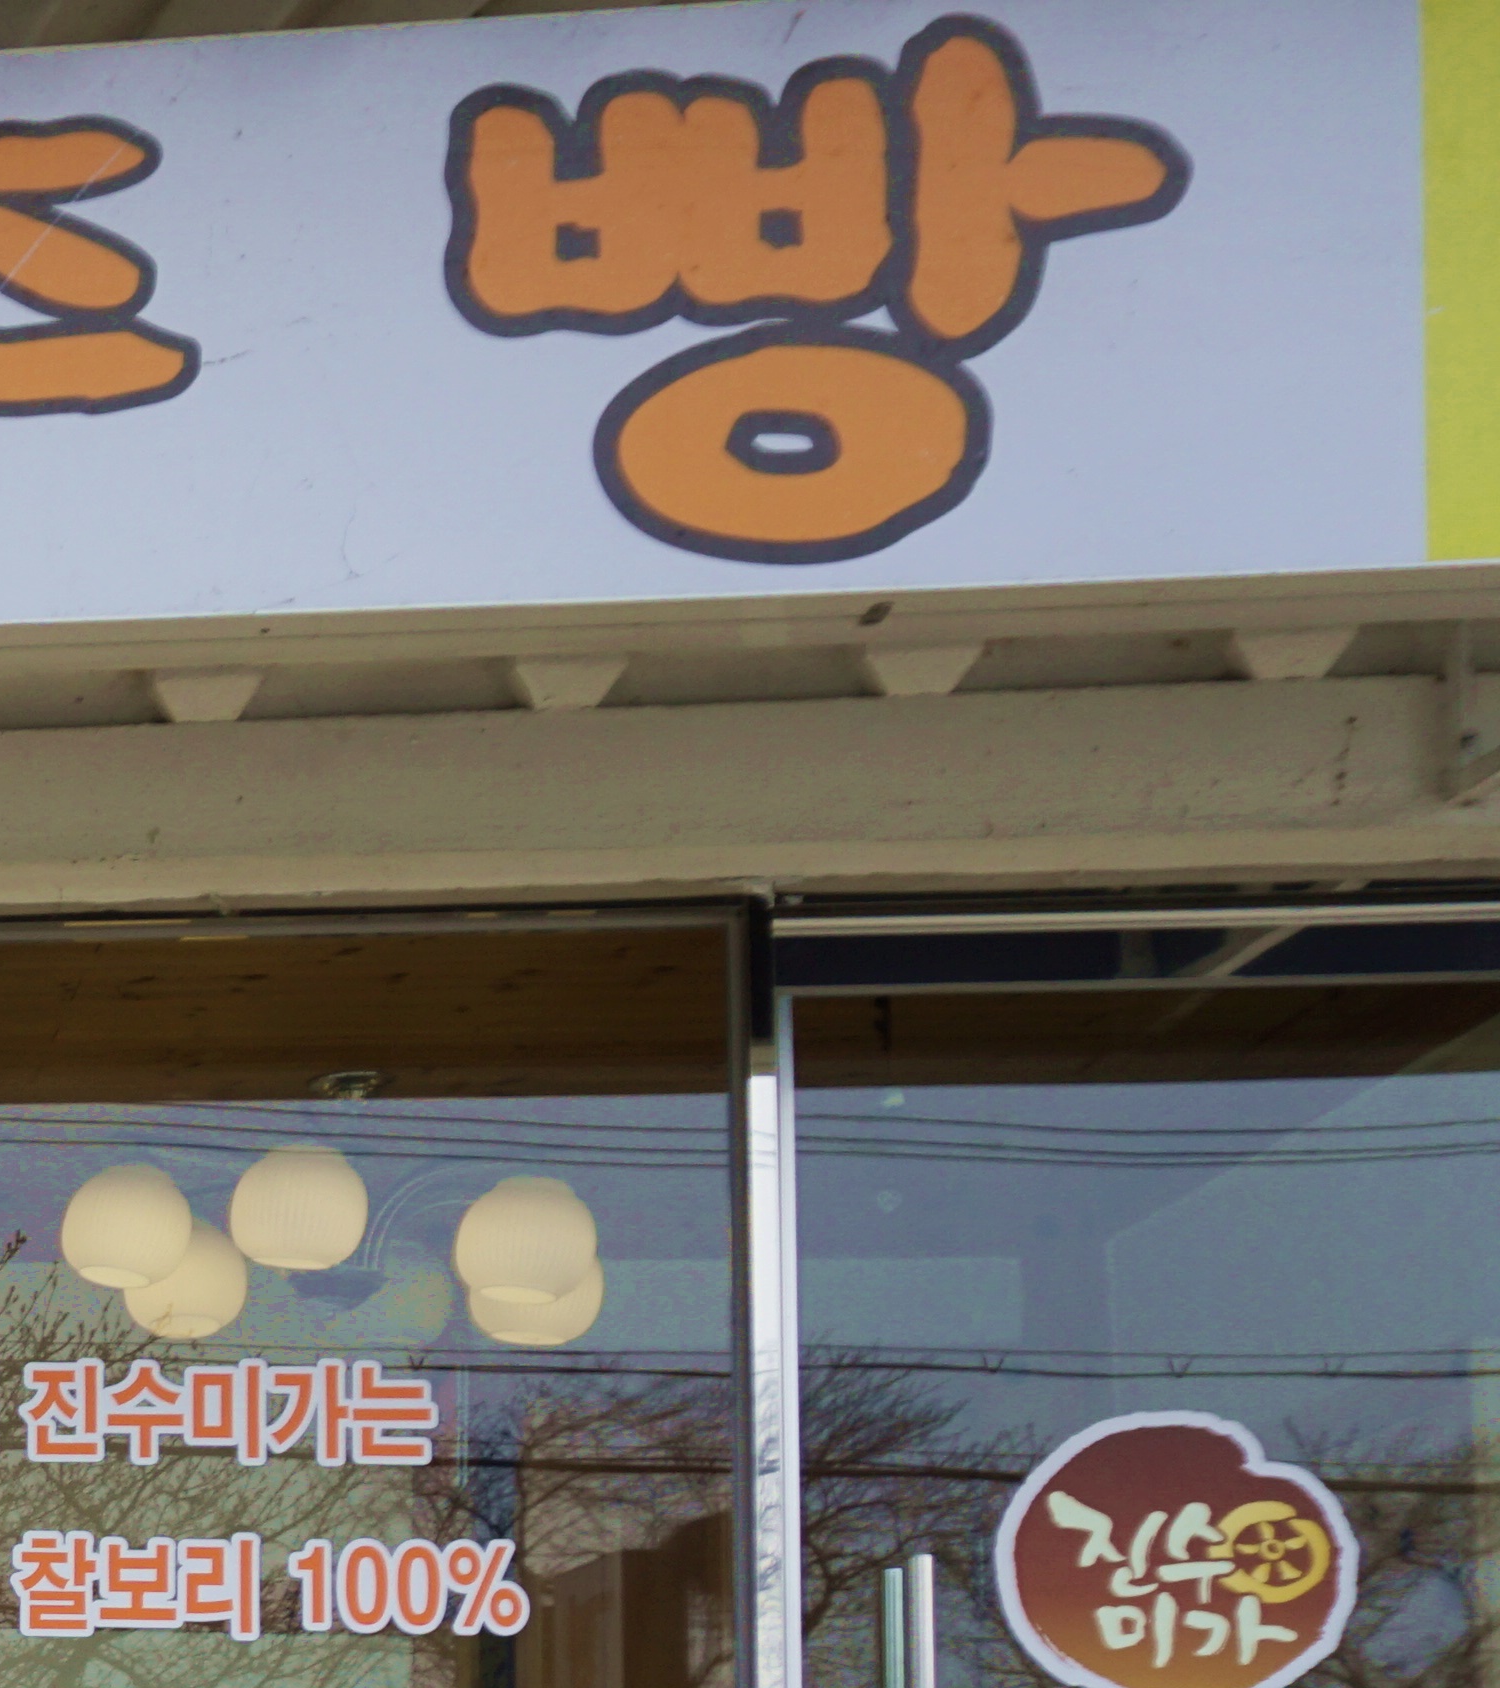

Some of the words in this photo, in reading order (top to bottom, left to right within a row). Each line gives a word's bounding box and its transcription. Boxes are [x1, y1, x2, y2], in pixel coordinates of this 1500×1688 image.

[18, 1358, 438, 1466] 진수미가는
[11, 1530, 263, 1641] 찰보리
[287, 1536, 531, 1637] 100%
[1047, 1490, 1238, 1599] 진수
[1093, 1594, 1299, 1668] 미가
